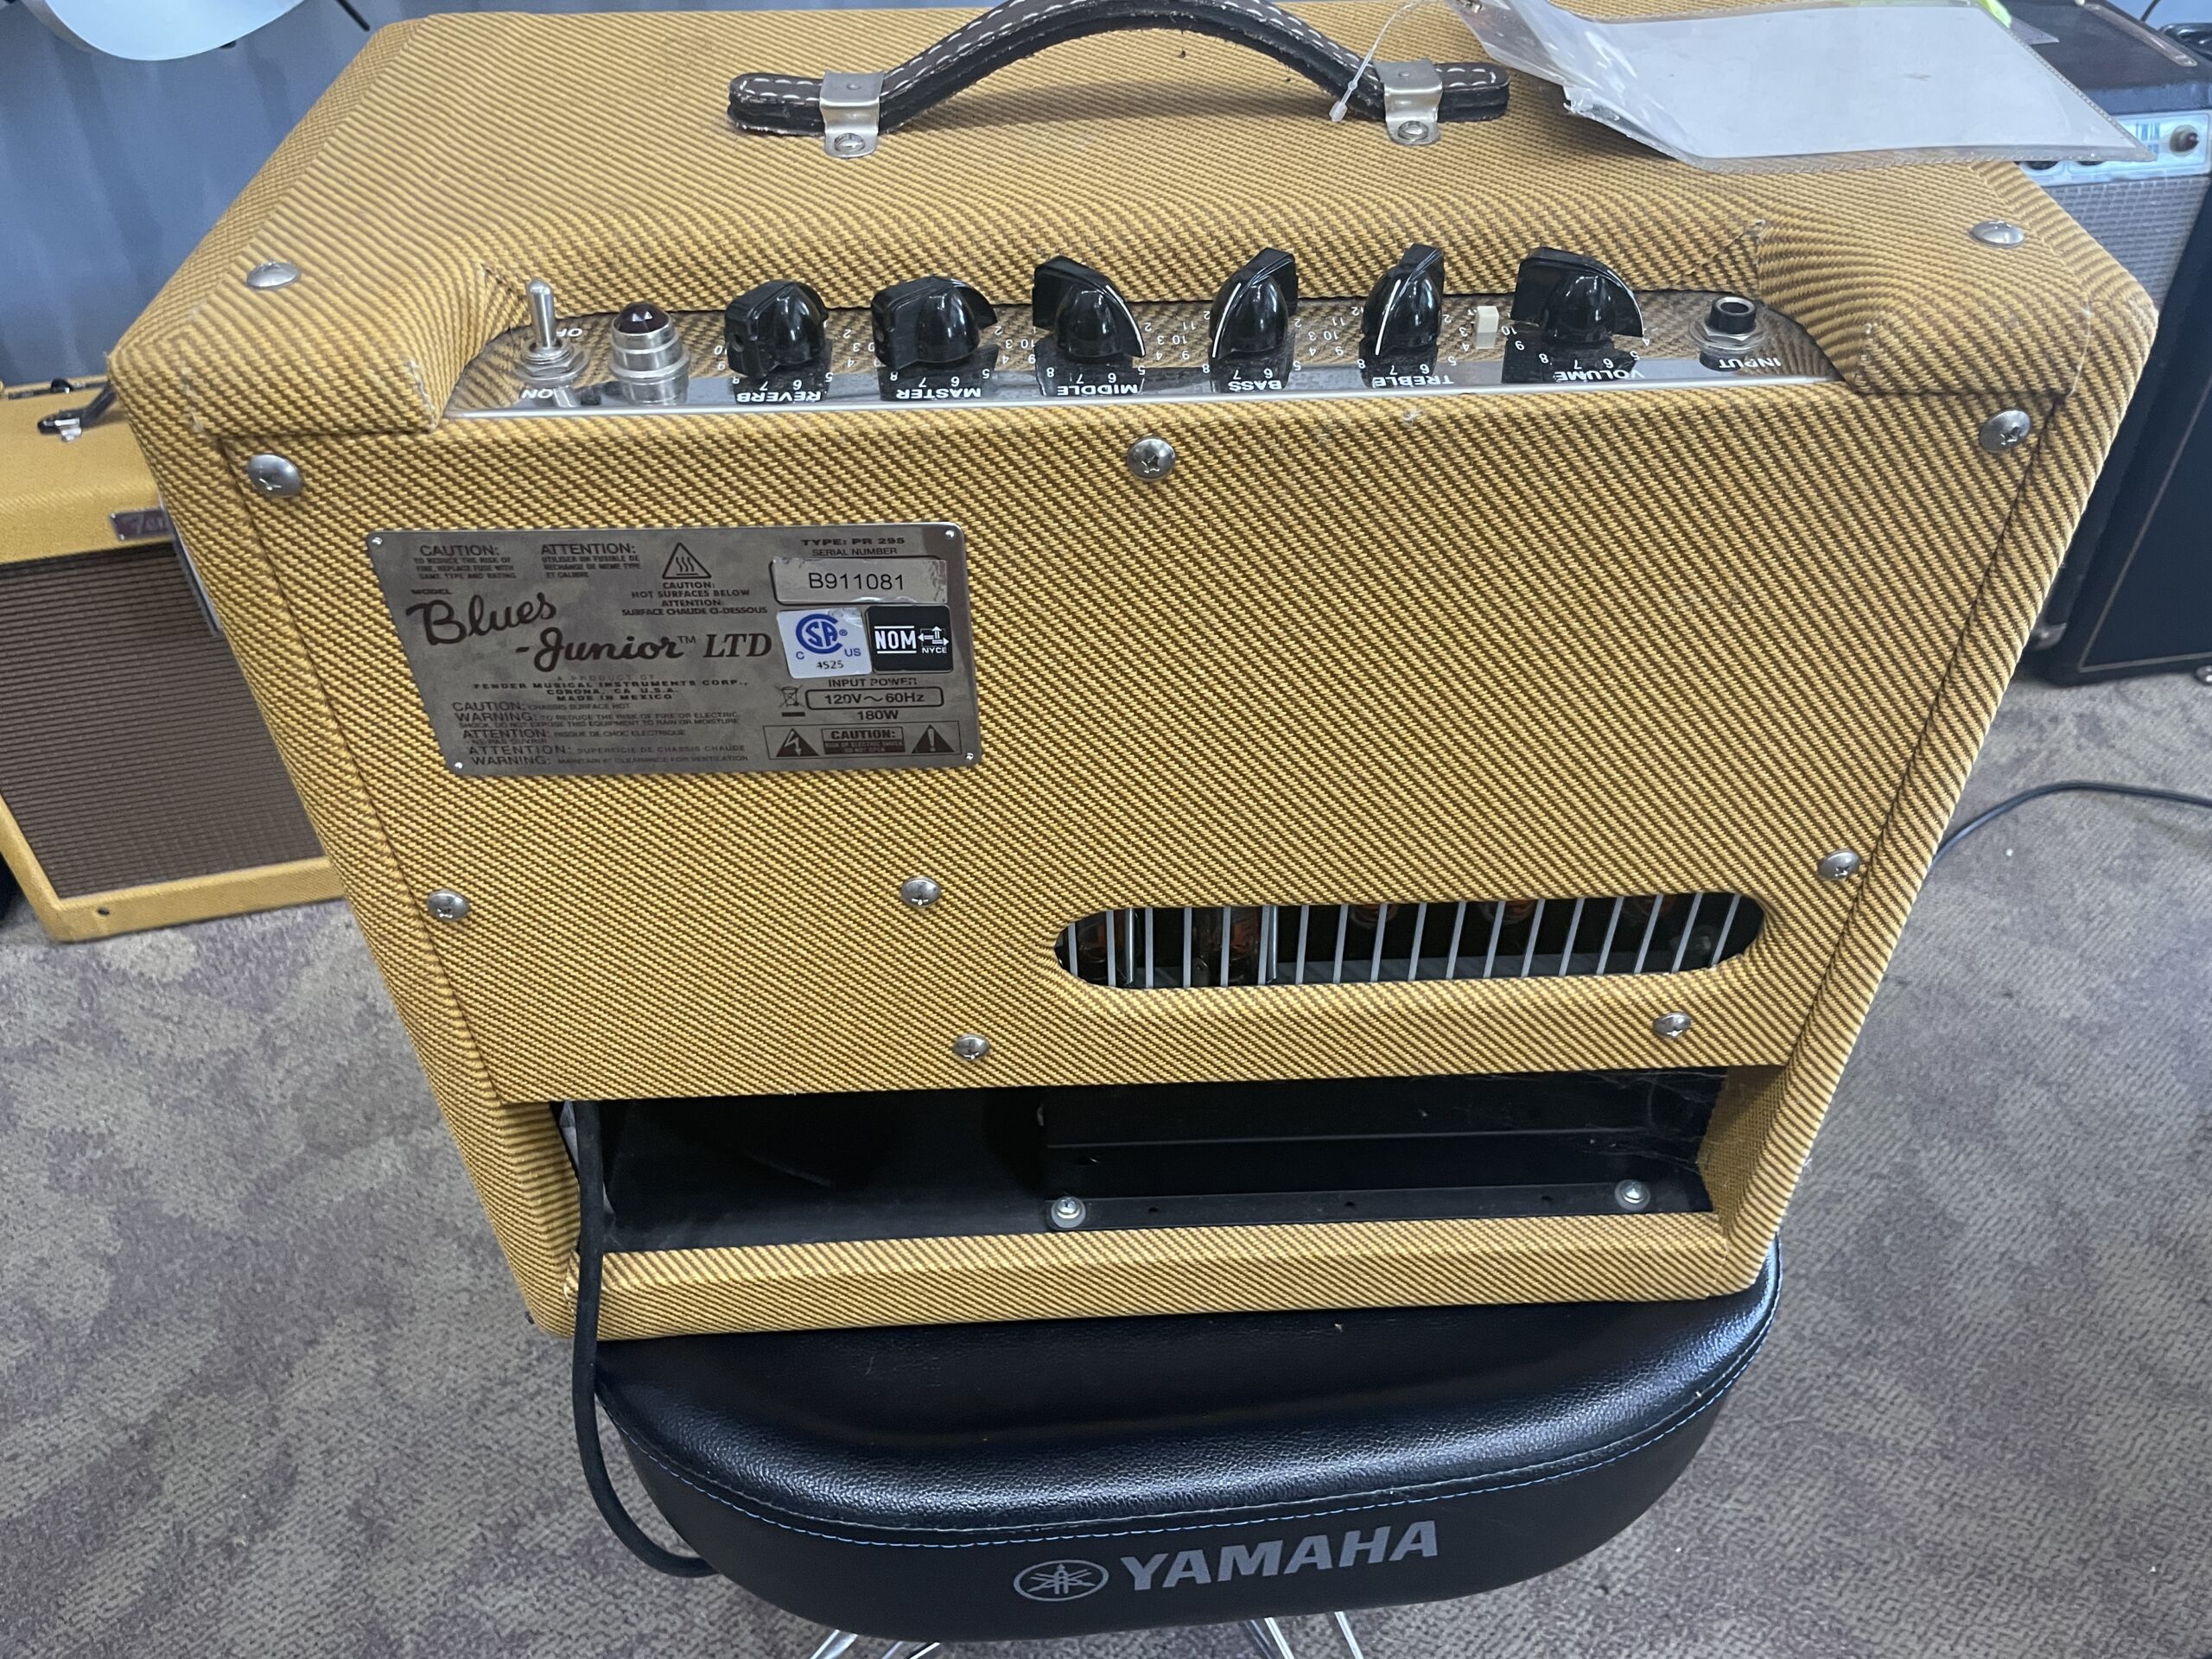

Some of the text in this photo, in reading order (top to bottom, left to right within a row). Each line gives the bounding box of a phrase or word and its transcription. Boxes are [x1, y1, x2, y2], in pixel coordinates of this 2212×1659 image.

[1294, 319, 1303, 327] 2
[1332, 317, 1345, 327] 11
[1443, 315, 1452, 324] 2
[995, 326, 1003, 335] 2
[1144, 322, 1153, 332] 2
[1182, 321, 1197, 330] 11
[1501, 326, 1517, 335] 10
[556, 328, 582, 337] OF
[842, 329, 852, 339] 2
[1308, 331, 1317, 340] 3
[1324, 331, 1339, 340] 10
[1459, 327, 1468, 337] 3
[1005, 340, 1013, 348] 3
[1021, 339, 1035, 349] 10
[1157, 335, 1165, 345] 3
[1172, 334, 1188, 345] 10
[852, 342, 861, 352] 3
[1461, 342, 1470, 352] 4
[1515, 340, 1525, 351] 9
[1155, 351, 1163, 360] 4
[1181, 351, 1190, 360] 9
[1308, 347, 1317, 356] 4
[1335, 346, 1344, 356] 9
[1630, 350, 1640, 361] 5
[847, 359, 856, 368] 4
[1002, 355, 1010, 365] 4
[1027, 354, 1036, 365] 9
[1447, 356, 1457, 366] 5
[1538, 353, 1549, 364] 8
[1603, 358, 1614, 369] 6
[1719, 358, 1782, 369] INPUT
[717, 361, 726, 371] 9
[1202, 364, 1210, 373] 8
[1293, 361, 1301, 371] 5
[1357, 359, 1366, 369] 8
[1420, 364, 1430, 374] 6
[1573, 359, 1582, 370] 7
[982, 369, 990, 379] 5
[1046, 366, 1054, 378] 8
[1138, 365, 1146, 375] 5
[1232, 369, 1241, 380] 7
[1263, 368, 1274, 378] 6
[1389, 365, 1397, 376] 7
[825, 372, 835, 383] 5
[890, 372, 899, 381] 8
[1076, 373, 1084, 384] 7
[1108, 372, 1117, 383] 6
[1554, 369, 1644, 382] VOLUME
[760, 380, 769, 391] 7
[792, 379, 803, 391] 6
[918, 377, 926, 388] 7
[950, 376, 960, 387] 6
[1228, 380, 1282, 391] BASS
[1372, 375, 1454, 387] TREBLE
[521, 389, 554, 398] ON
[896, 388, 982, 399] MASTER
[1057, 384, 1138, 396] MIDDLE
[736, 391, 821, 403] REVERB
[420, 545, 499, 556] CAUTION:
[541, 543, 636, 555] ATTENTION:
[808, 572, 904, 590] B911081
[405, 593, 556, 645] Blues
[874, 630, 918, 650] NOM
[703, 633, 772, 658] LTD
[844, 648, 861, 658] US
[817, 660, 843, 670] 4525
[828, 677, 917, 688] INPUT POWER
[452, 701, 526, 712] CAUTION:
[455, 712, 537, 721] WARNING:
[857, 709, 899, 720] 180W
[831, 729, 896, 740] CAUTION:
[469, 746, 571, 755] ATTENTION:
[471, 756, 551, 766] WARNING:
[1121, 1521, 1438, 1591] YAMAHA
